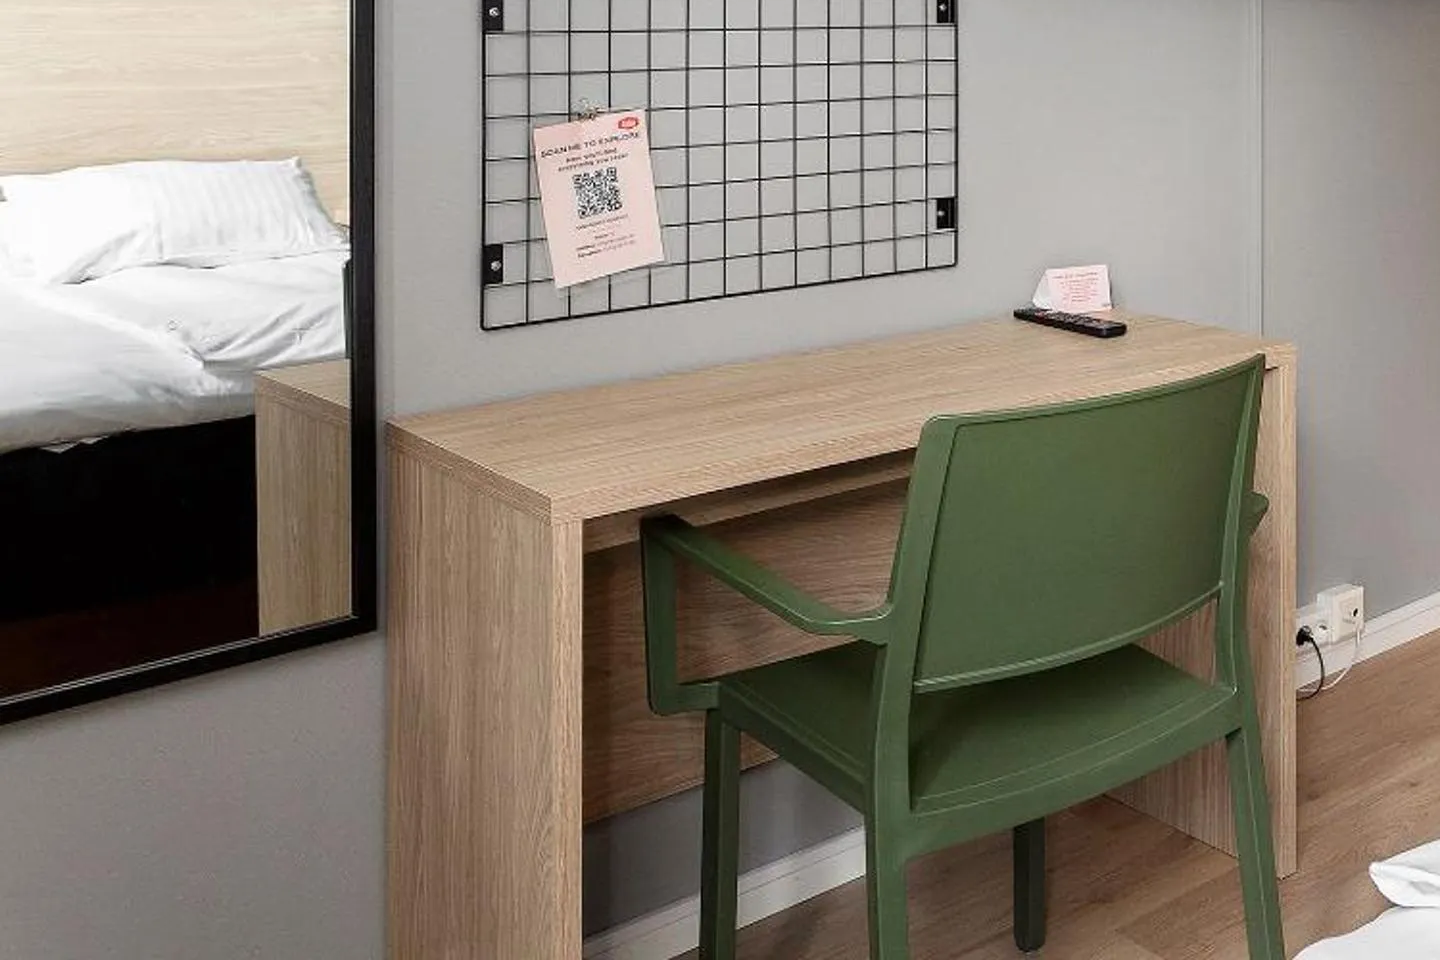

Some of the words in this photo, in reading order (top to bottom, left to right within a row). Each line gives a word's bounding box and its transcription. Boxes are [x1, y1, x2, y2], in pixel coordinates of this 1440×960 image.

[541, 146, 568, 159] SCAN
[584, 139, 597, 149] TO
[598, 131, 639, 145] EXPLORE
